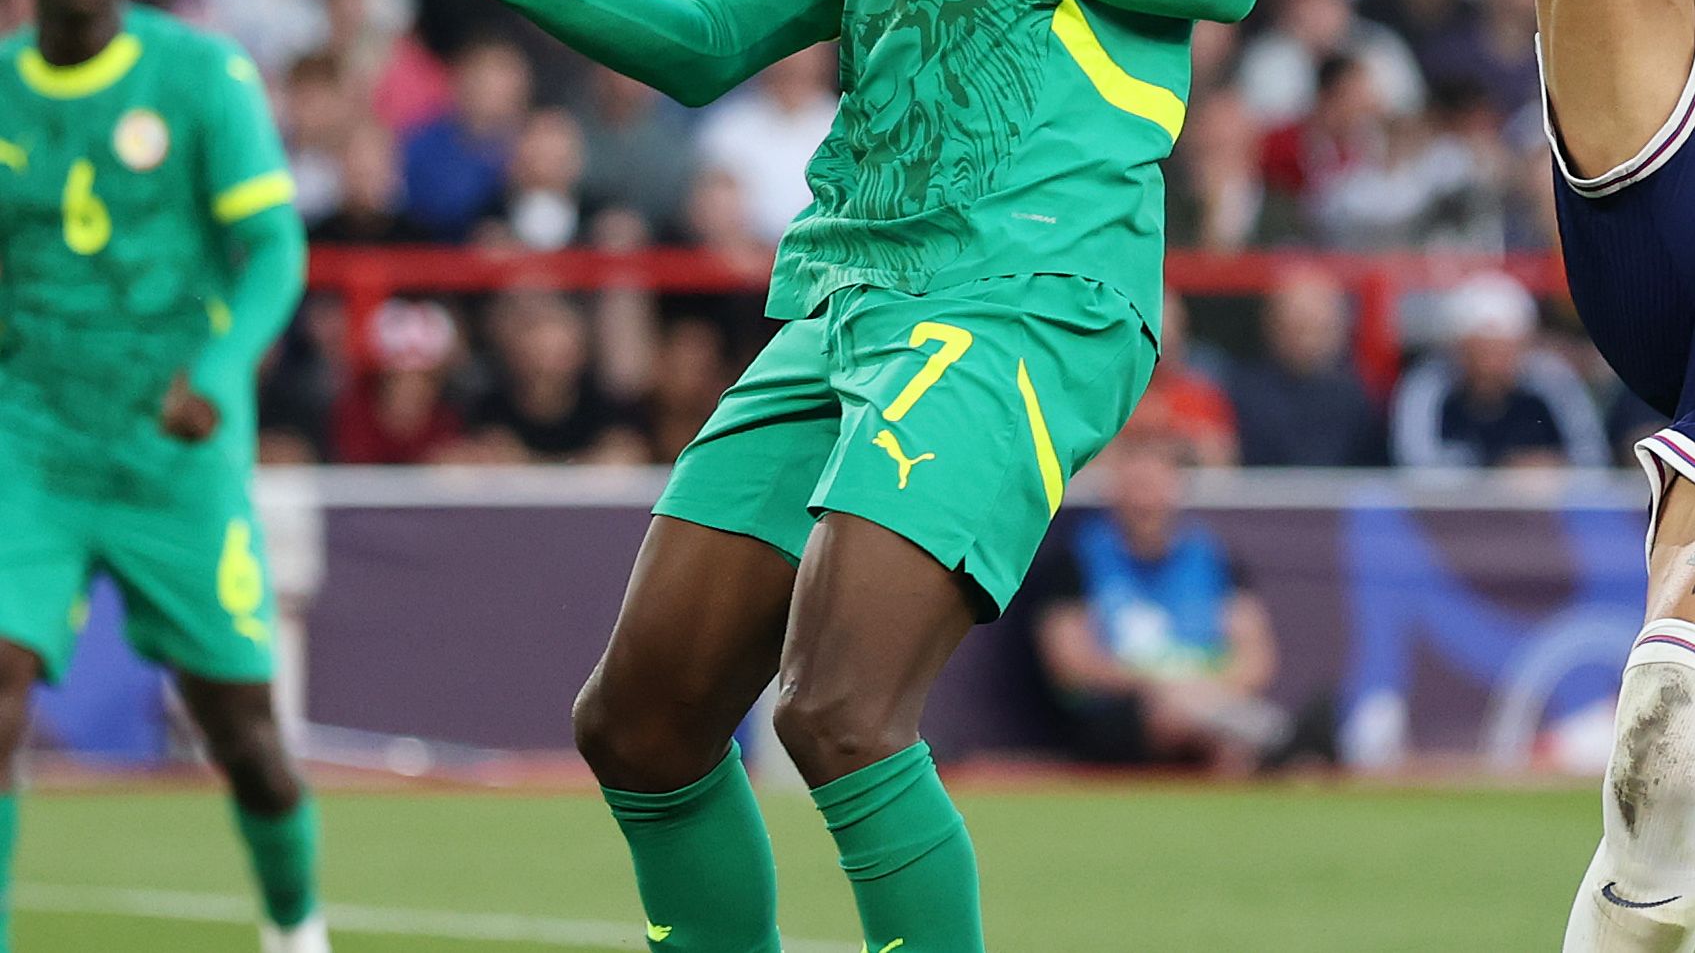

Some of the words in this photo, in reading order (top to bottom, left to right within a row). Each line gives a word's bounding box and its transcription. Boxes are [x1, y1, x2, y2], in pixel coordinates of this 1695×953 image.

[62, 157, 113, 257] 6
[882, 321, 973, 422] 7
[217, 518, 264, 615] 6
